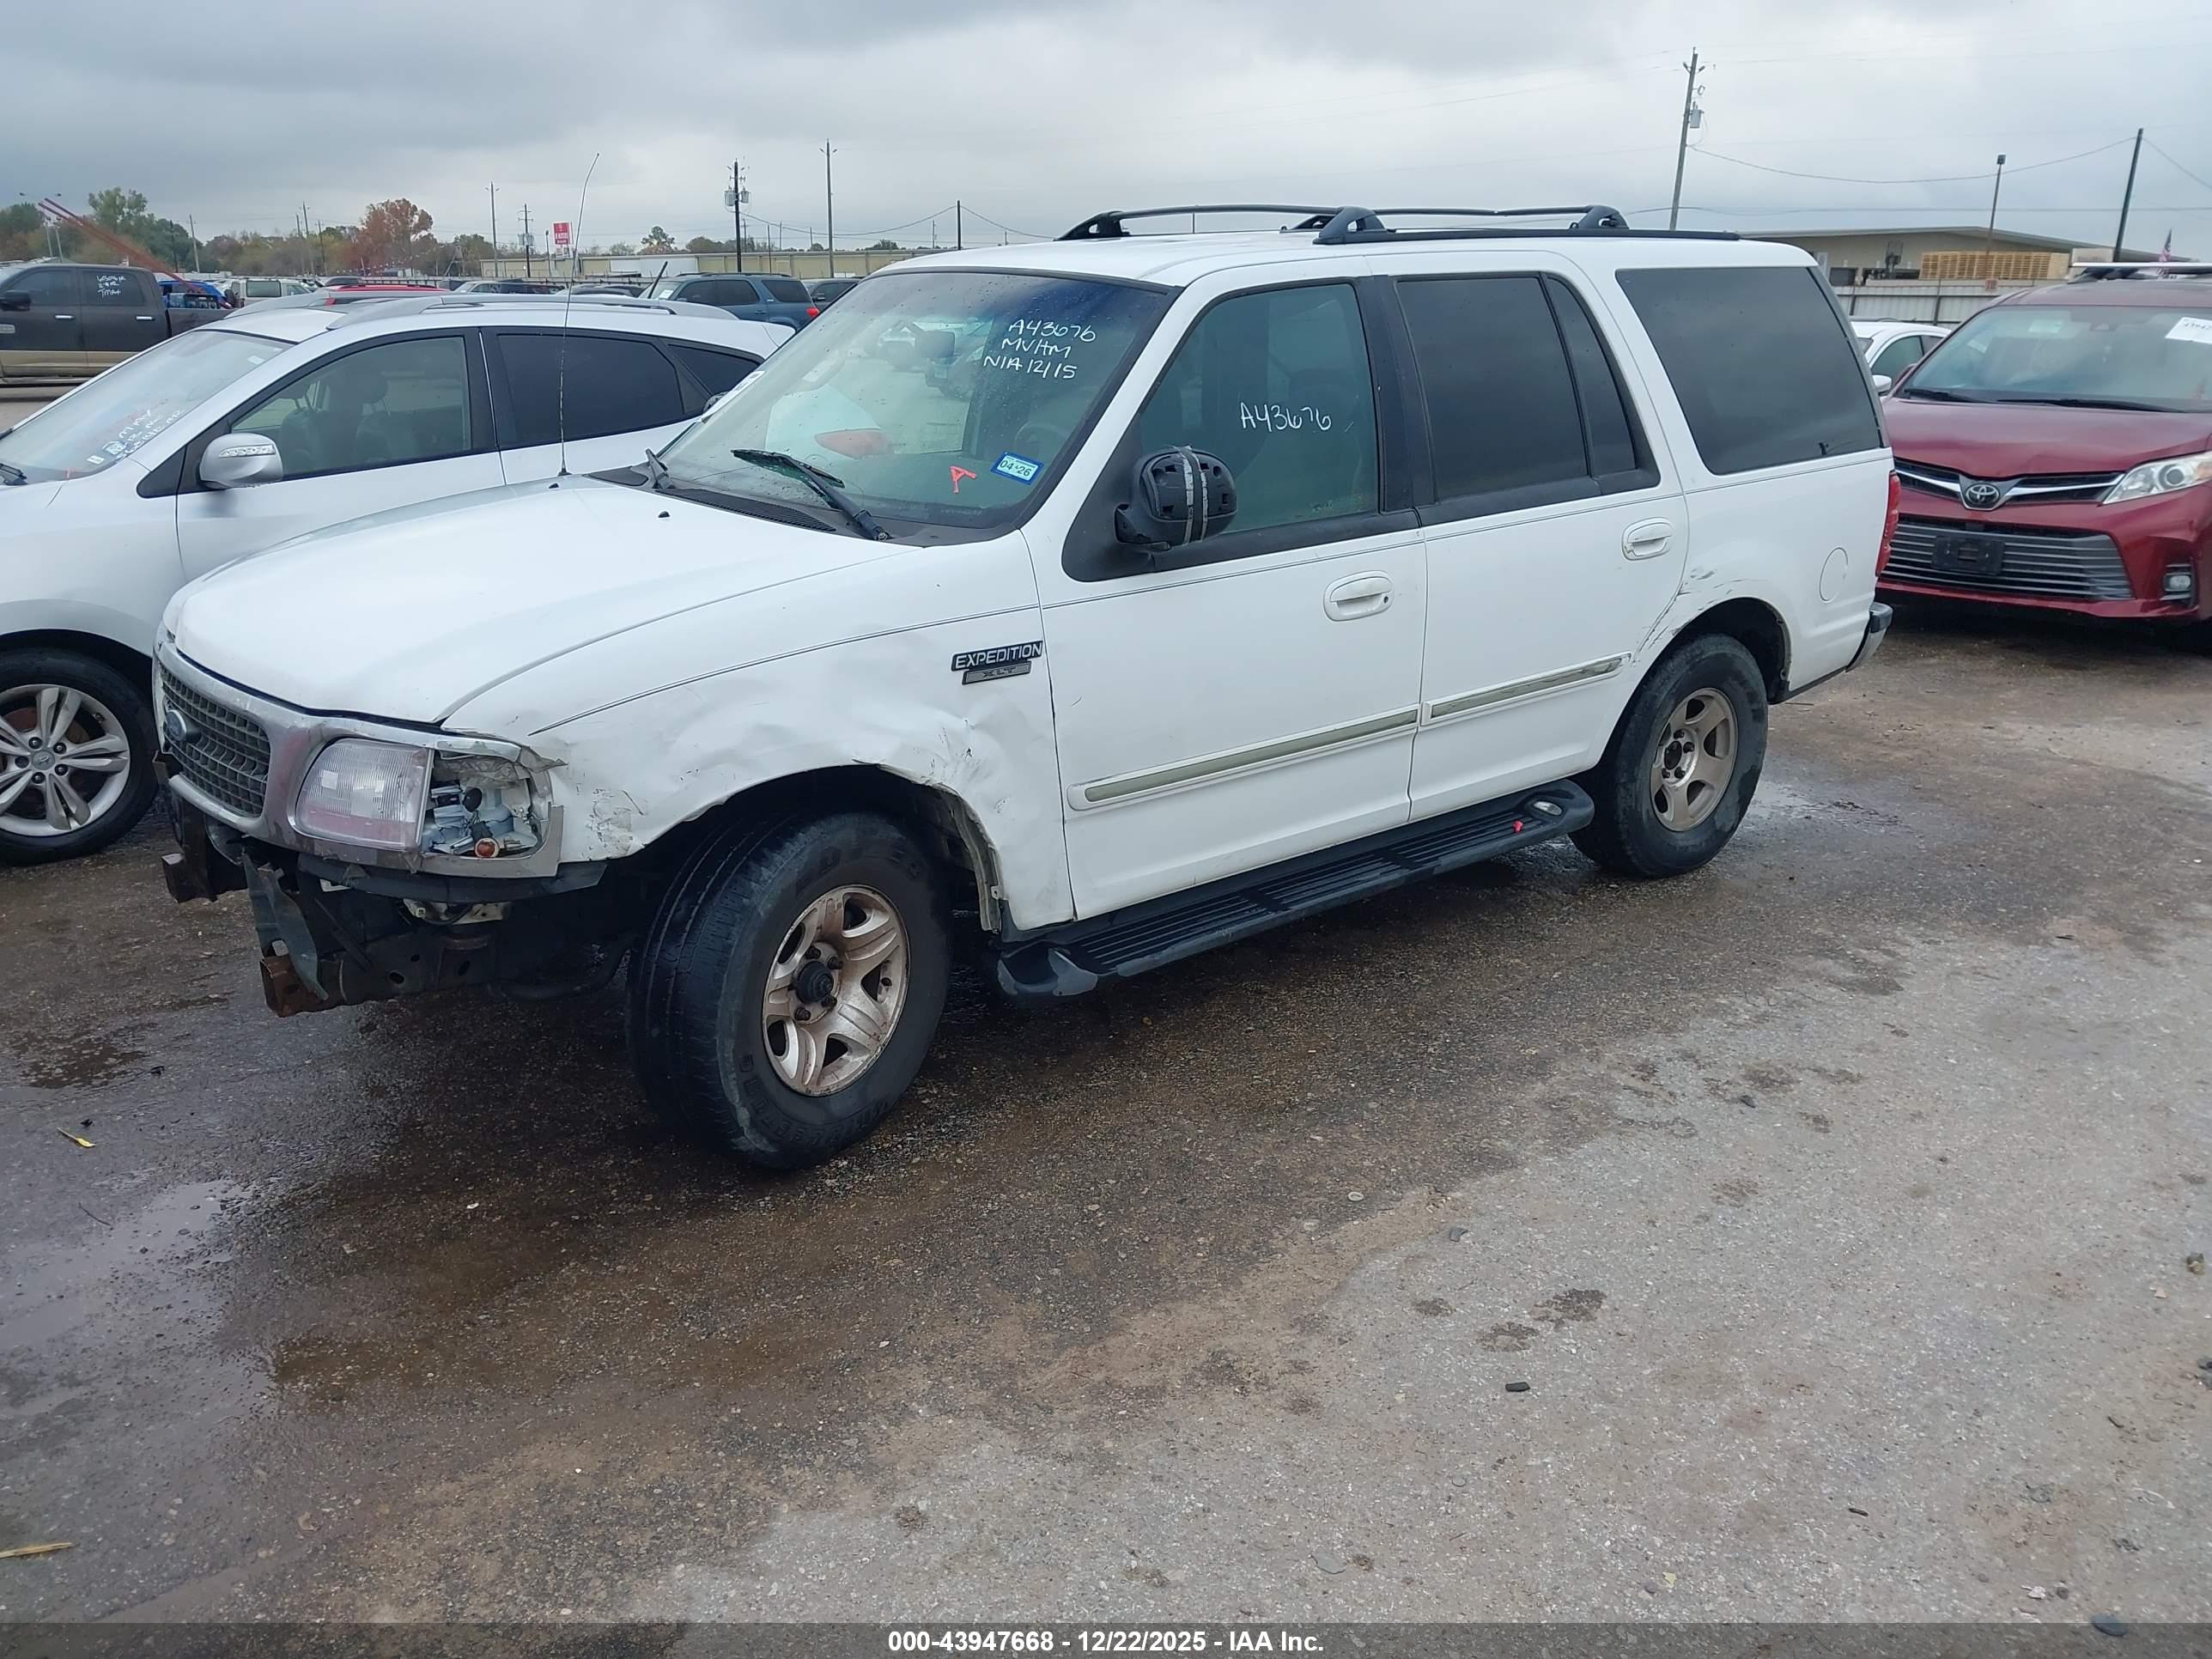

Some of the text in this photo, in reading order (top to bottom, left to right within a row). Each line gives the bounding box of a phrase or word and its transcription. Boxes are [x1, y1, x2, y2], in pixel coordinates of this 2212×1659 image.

[1008, 319, 1097, 342] A43676
[1026, 359, 1078, 379] 12/15
[1240, 401, 1332, 433] A43676
[1000, 459, 1014, 471] 04
[954, 641, 1043, 669] EXPEDITION
[981, 665, 1017, 678] XLT
